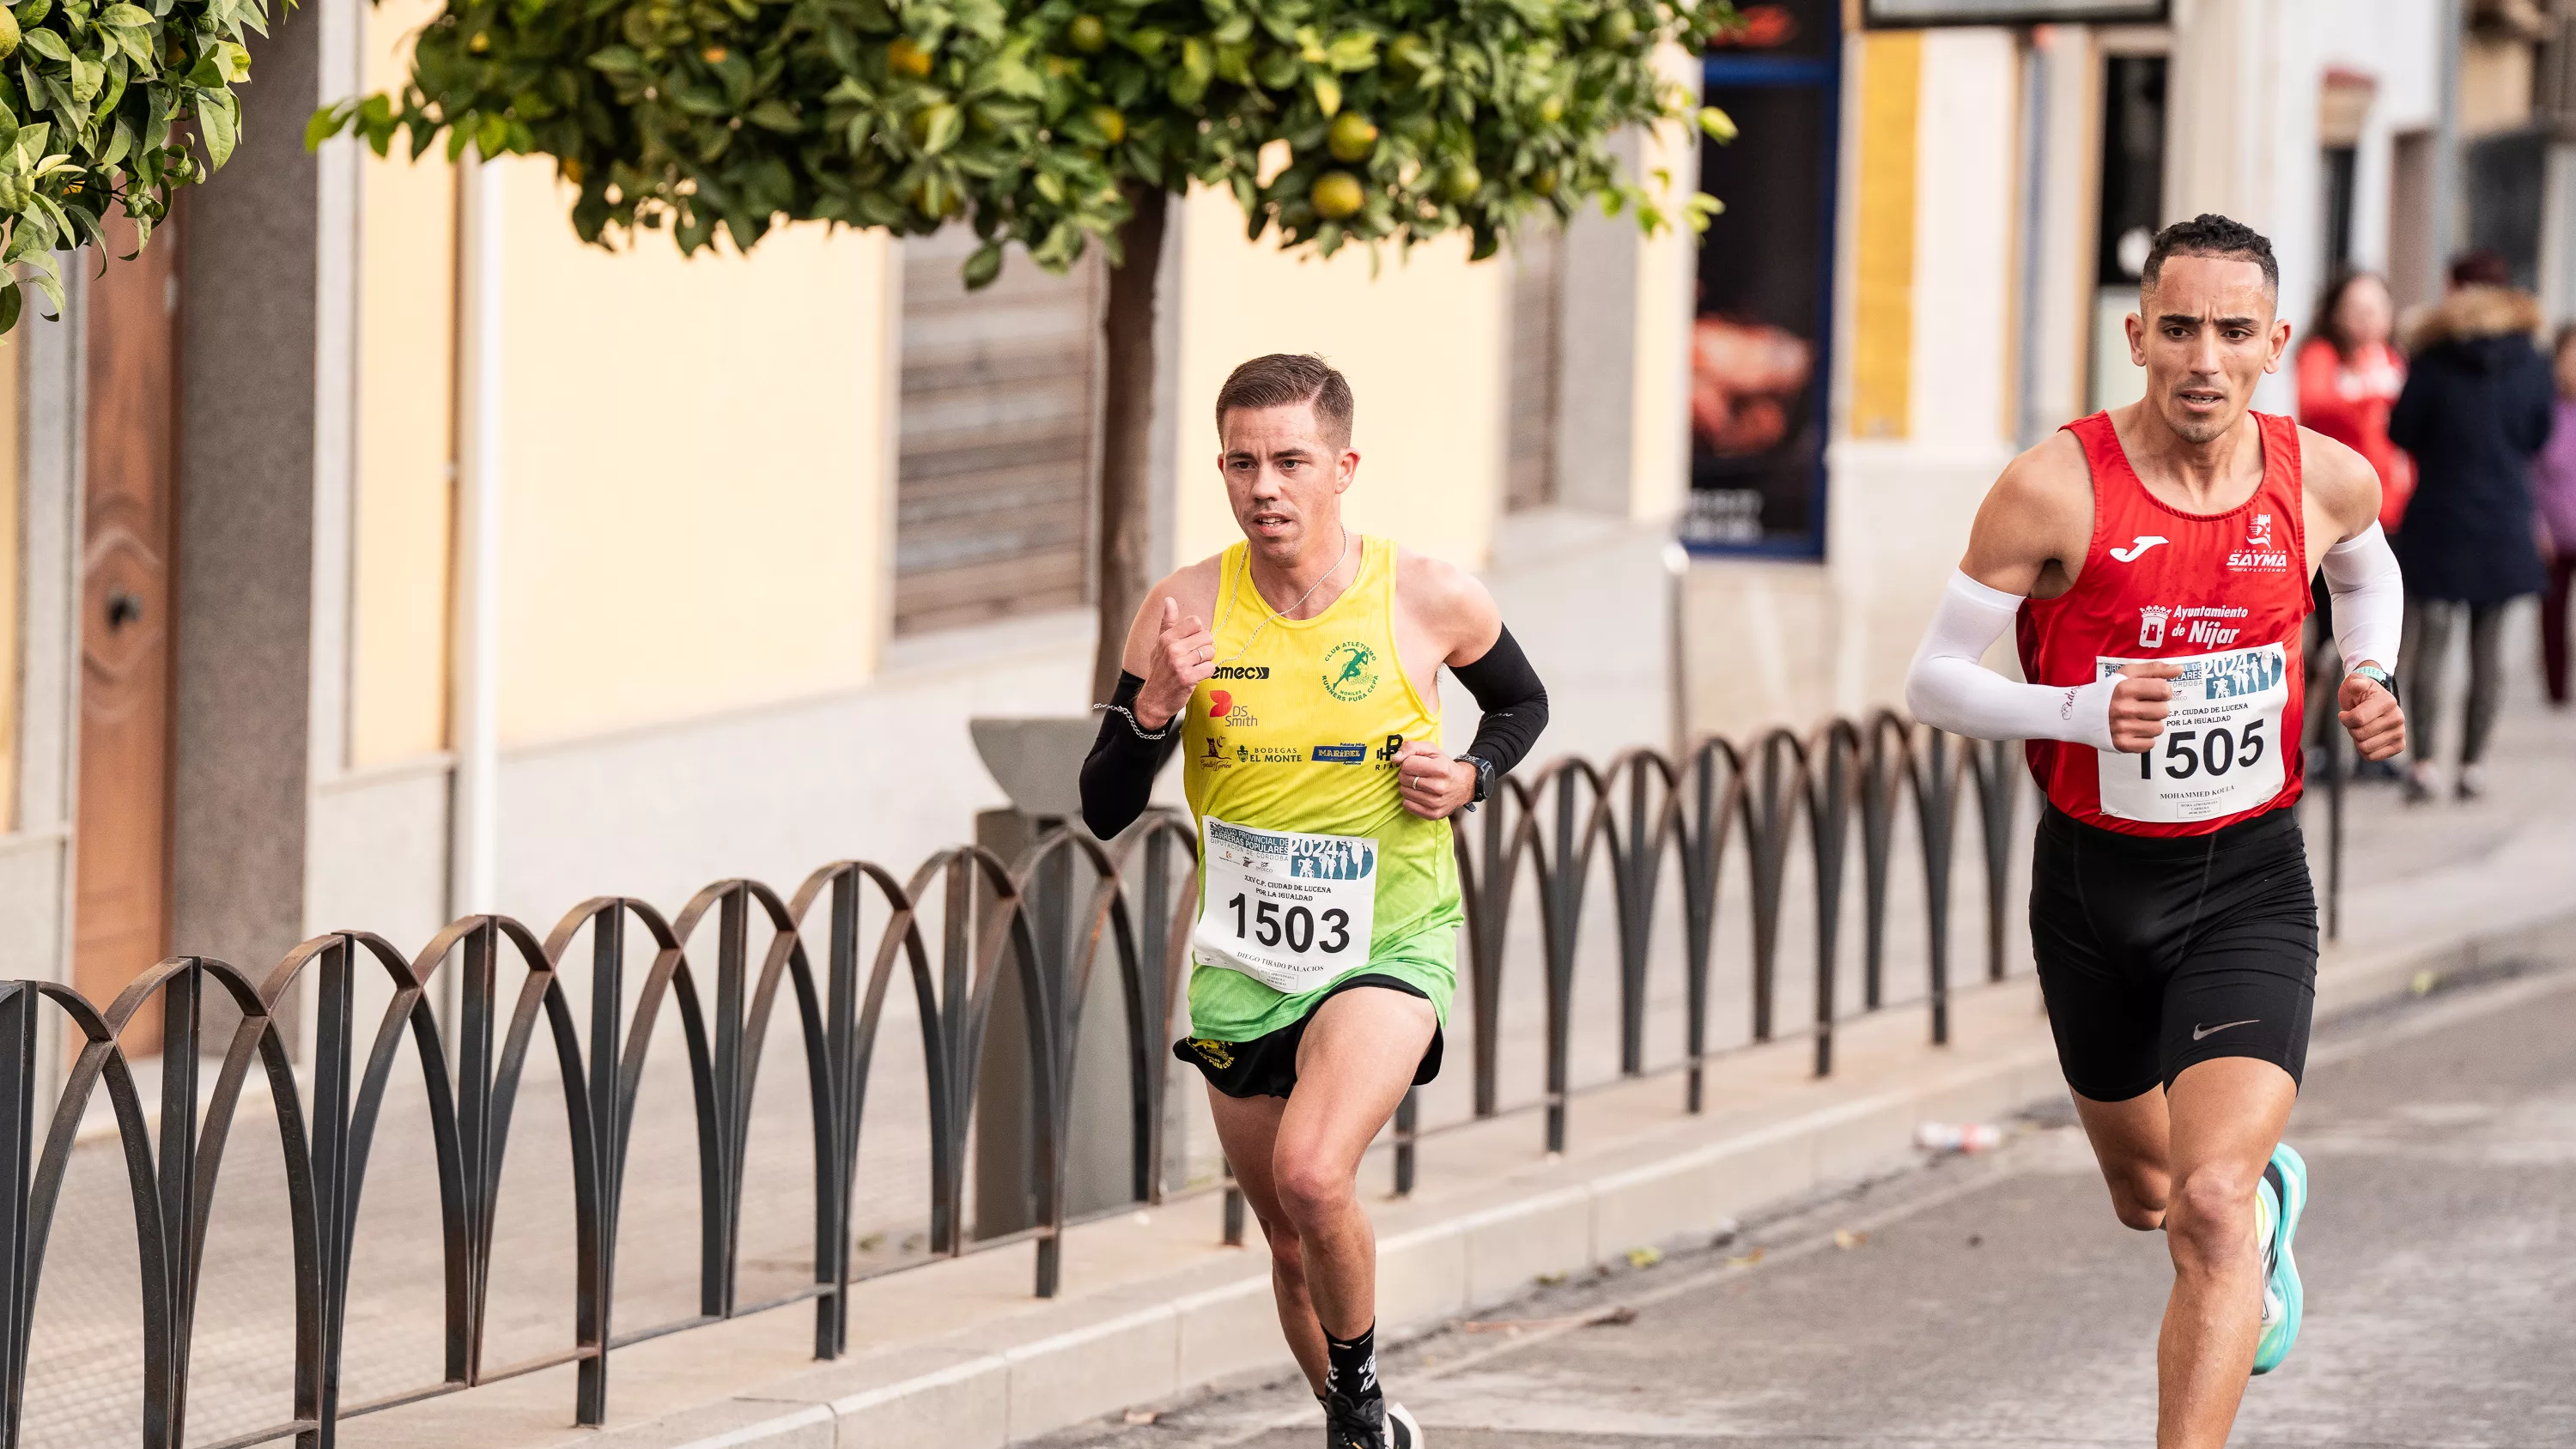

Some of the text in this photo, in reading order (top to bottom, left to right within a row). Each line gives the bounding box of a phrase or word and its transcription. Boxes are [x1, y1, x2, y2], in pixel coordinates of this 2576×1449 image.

[2226, 554, 2287, 567] SAYMA
[2173, 604, 2249, 621] Ayuntamiento
[2172, 621, 2240, 650] de Níjar
[1324, 641, 1376, 662] CLUB ATLETISMO
[2202, 652, 2250, 679] 2024
[1321, 675, 1379, 702] RUNNERS PURA CEPA
[1232, 706, 1249, 718] DS
[2221, 702, 2249, 712] LUCENA
[1225, 715, 1258, 727] Smith
[2194, 715, 2232, 724] IGUALDAD
[1250, 755, 1303, 763] EL MONTE
[2160, 785, 2234, 799] MOHAMMED KOULA
[1210, 829, 1289, 855] CARRERAS POPULARES
[1238, 830, 1277, 846] PROVINCIAL
[1290, 838, 1339, 858] 2024
[1255, 887, 1267, 897] POR
[1278, 892, 1313, 901] IGUALDAD
[1267, 882, 1292, 890] CIUDAD
[1304, 885, 1332, 894] LUCENA
[1229, 892, 1350, 954] 1503
[1236, 951, 1324, 973] DIEGO TIRADO PALACIOS
